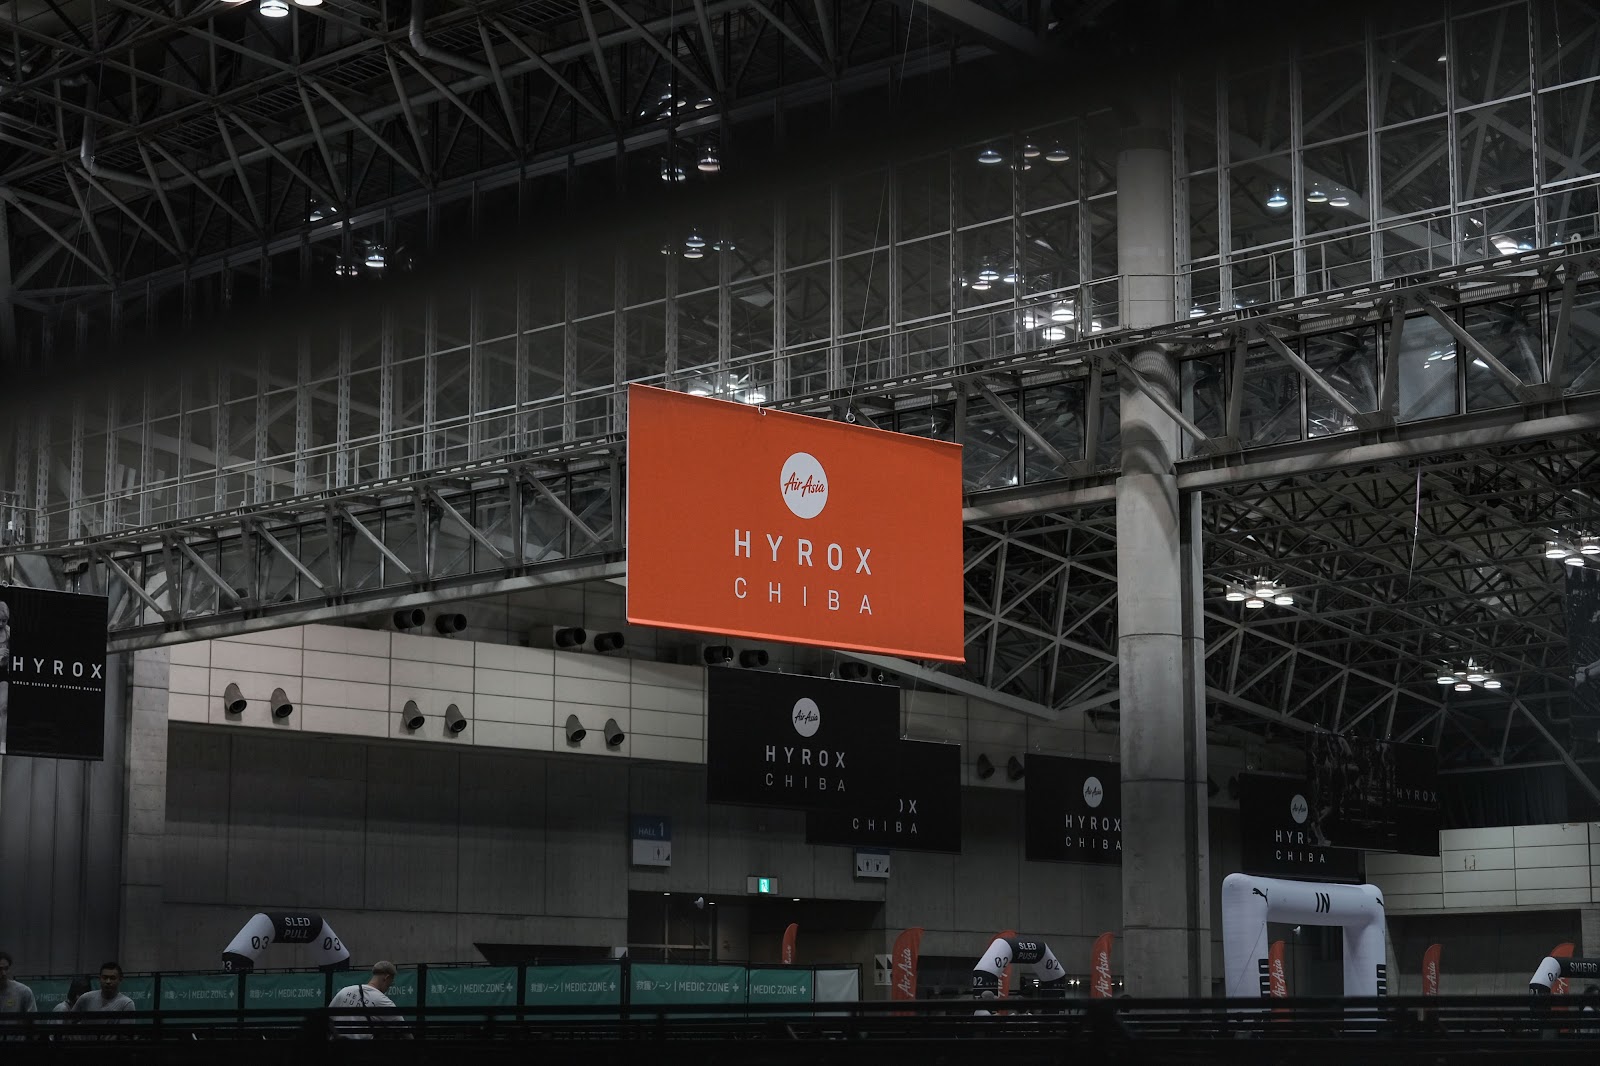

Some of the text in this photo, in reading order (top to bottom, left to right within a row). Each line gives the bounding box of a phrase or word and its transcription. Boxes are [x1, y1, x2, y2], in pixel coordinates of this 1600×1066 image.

[735, 529, 872, 575] HYROX
[735, 577, 872, 615] CHIBA
[12, 656, 102, 679] HYROX
[766, 745, 846, 768] HYROX
[766, 773, 846, 792] CHIBA
[1396, 788, 1436, 802] HYROX
[660, 822, 664, 837] 1
[852, 818, 918, 834] CHIBA
[1066, 814, 1121, 832] HYROX
[1066, 836, 1122, 850] CHIBA
[1276, 830, 1304, 844] HYR
[1276, 850, 1326, 863] CHIBA
[1316, 892, 1330, 913] IN
[285, 917, 310, 927] SLED
[284, 929, 308, 939] PULL
[252, 936, 270, 950] 03
[324, 937, 341, 950] 03
[1018, 942, 1037, 950] SLED
[994, 956, 1008, 968] 02
[1017, 952, 1038, 960] PUSH
[1046, 959, 1060, 970] 02
[1570, 962, 1598, 973] SKIERG
[278, 989, 297, 998] MEDIC
[298, 988, 314, 997] ZONE
[388, 986, 406, 995] ZONE
[464, 984, 484, 993] MEDIC
[486, 983, 505, 992] ZONE
[565, 982, 587, 992] MEDIC
[588, 982, 608, 992] ZONE
[679, 982, 706, 992] MEDIC
[707, 982, 729, 992] ZONE
[754, 985, 797, 994] MEDIC ZONE
